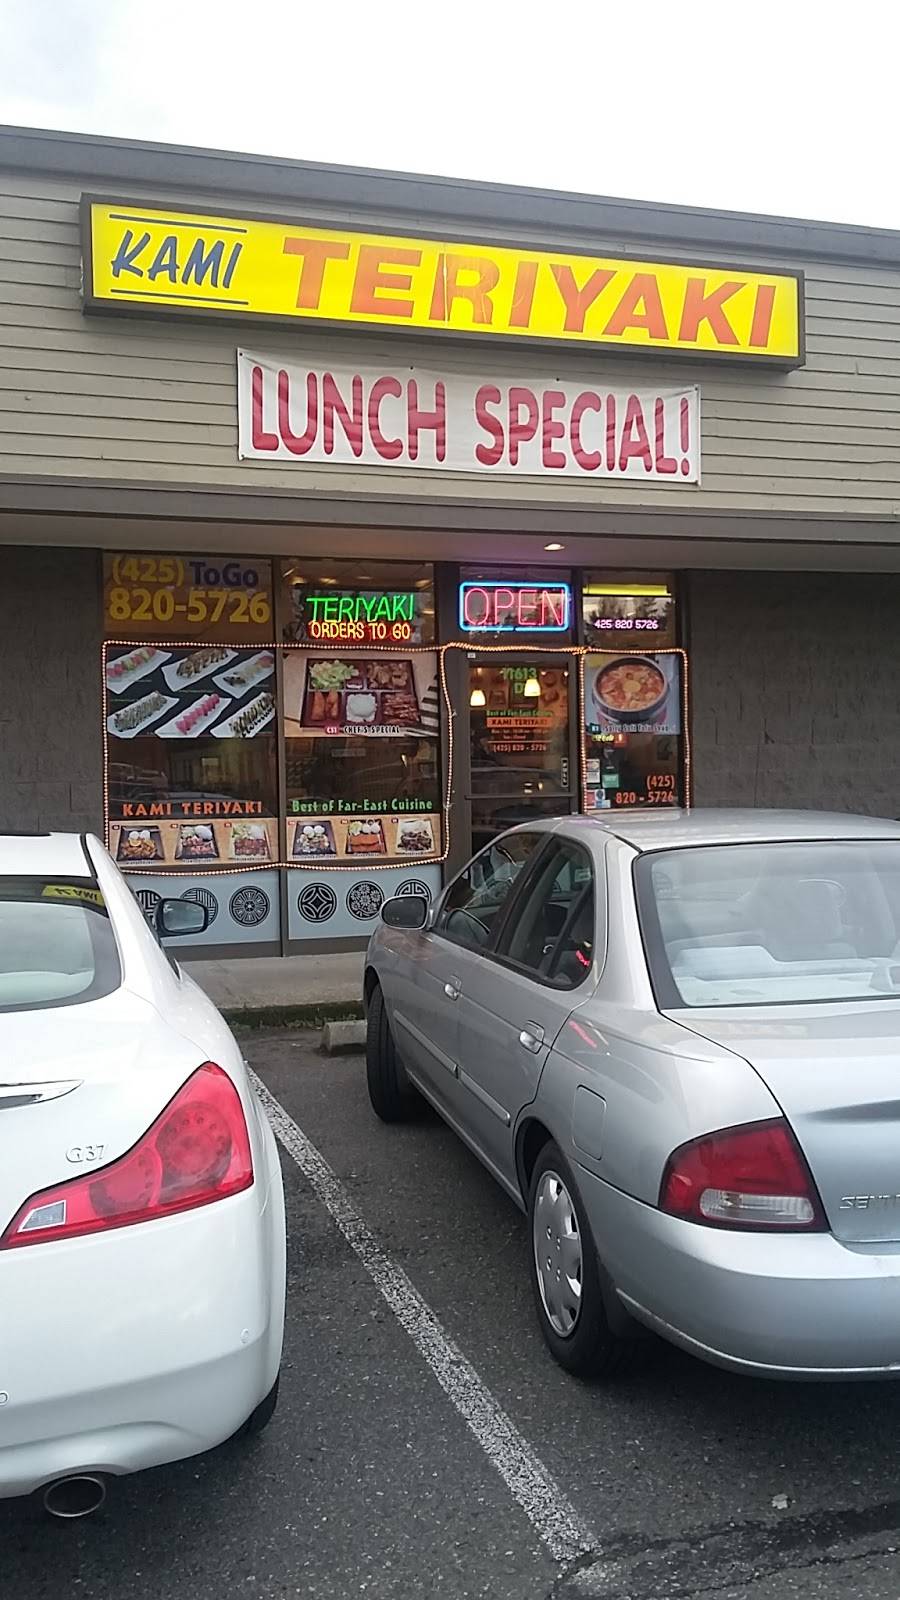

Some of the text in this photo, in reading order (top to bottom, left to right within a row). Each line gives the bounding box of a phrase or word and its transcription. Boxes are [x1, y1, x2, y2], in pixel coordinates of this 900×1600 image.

[110, 229, 778, 349] KAMI TERIYAKI
[251, 366, 690, 478] LUNCH SPECIAL!
[112, 558, 185, 586] (425)
[109, 587, 270, 624] 820-5726
[306, 593, 414, 622] TERIYAKI
[464, 588, 564, 626] OPEN
[311, 621, 411, 639] ORDERS TO GO
[594, 620, 659, 629] 425 820 5726
[646, 774, 675, 790] (425)
[292, 800, 319, 813] Best
[338, 799, 388, 812] Far-East
[391, 798, 433, 811] Cuisine
[615, 792, 636, 804] 820
[647, 791, 674, 803] 5726
[122, 801, 263, 817] KAMI TERIYAKI
[65, 1145, 108, 1163] G37
